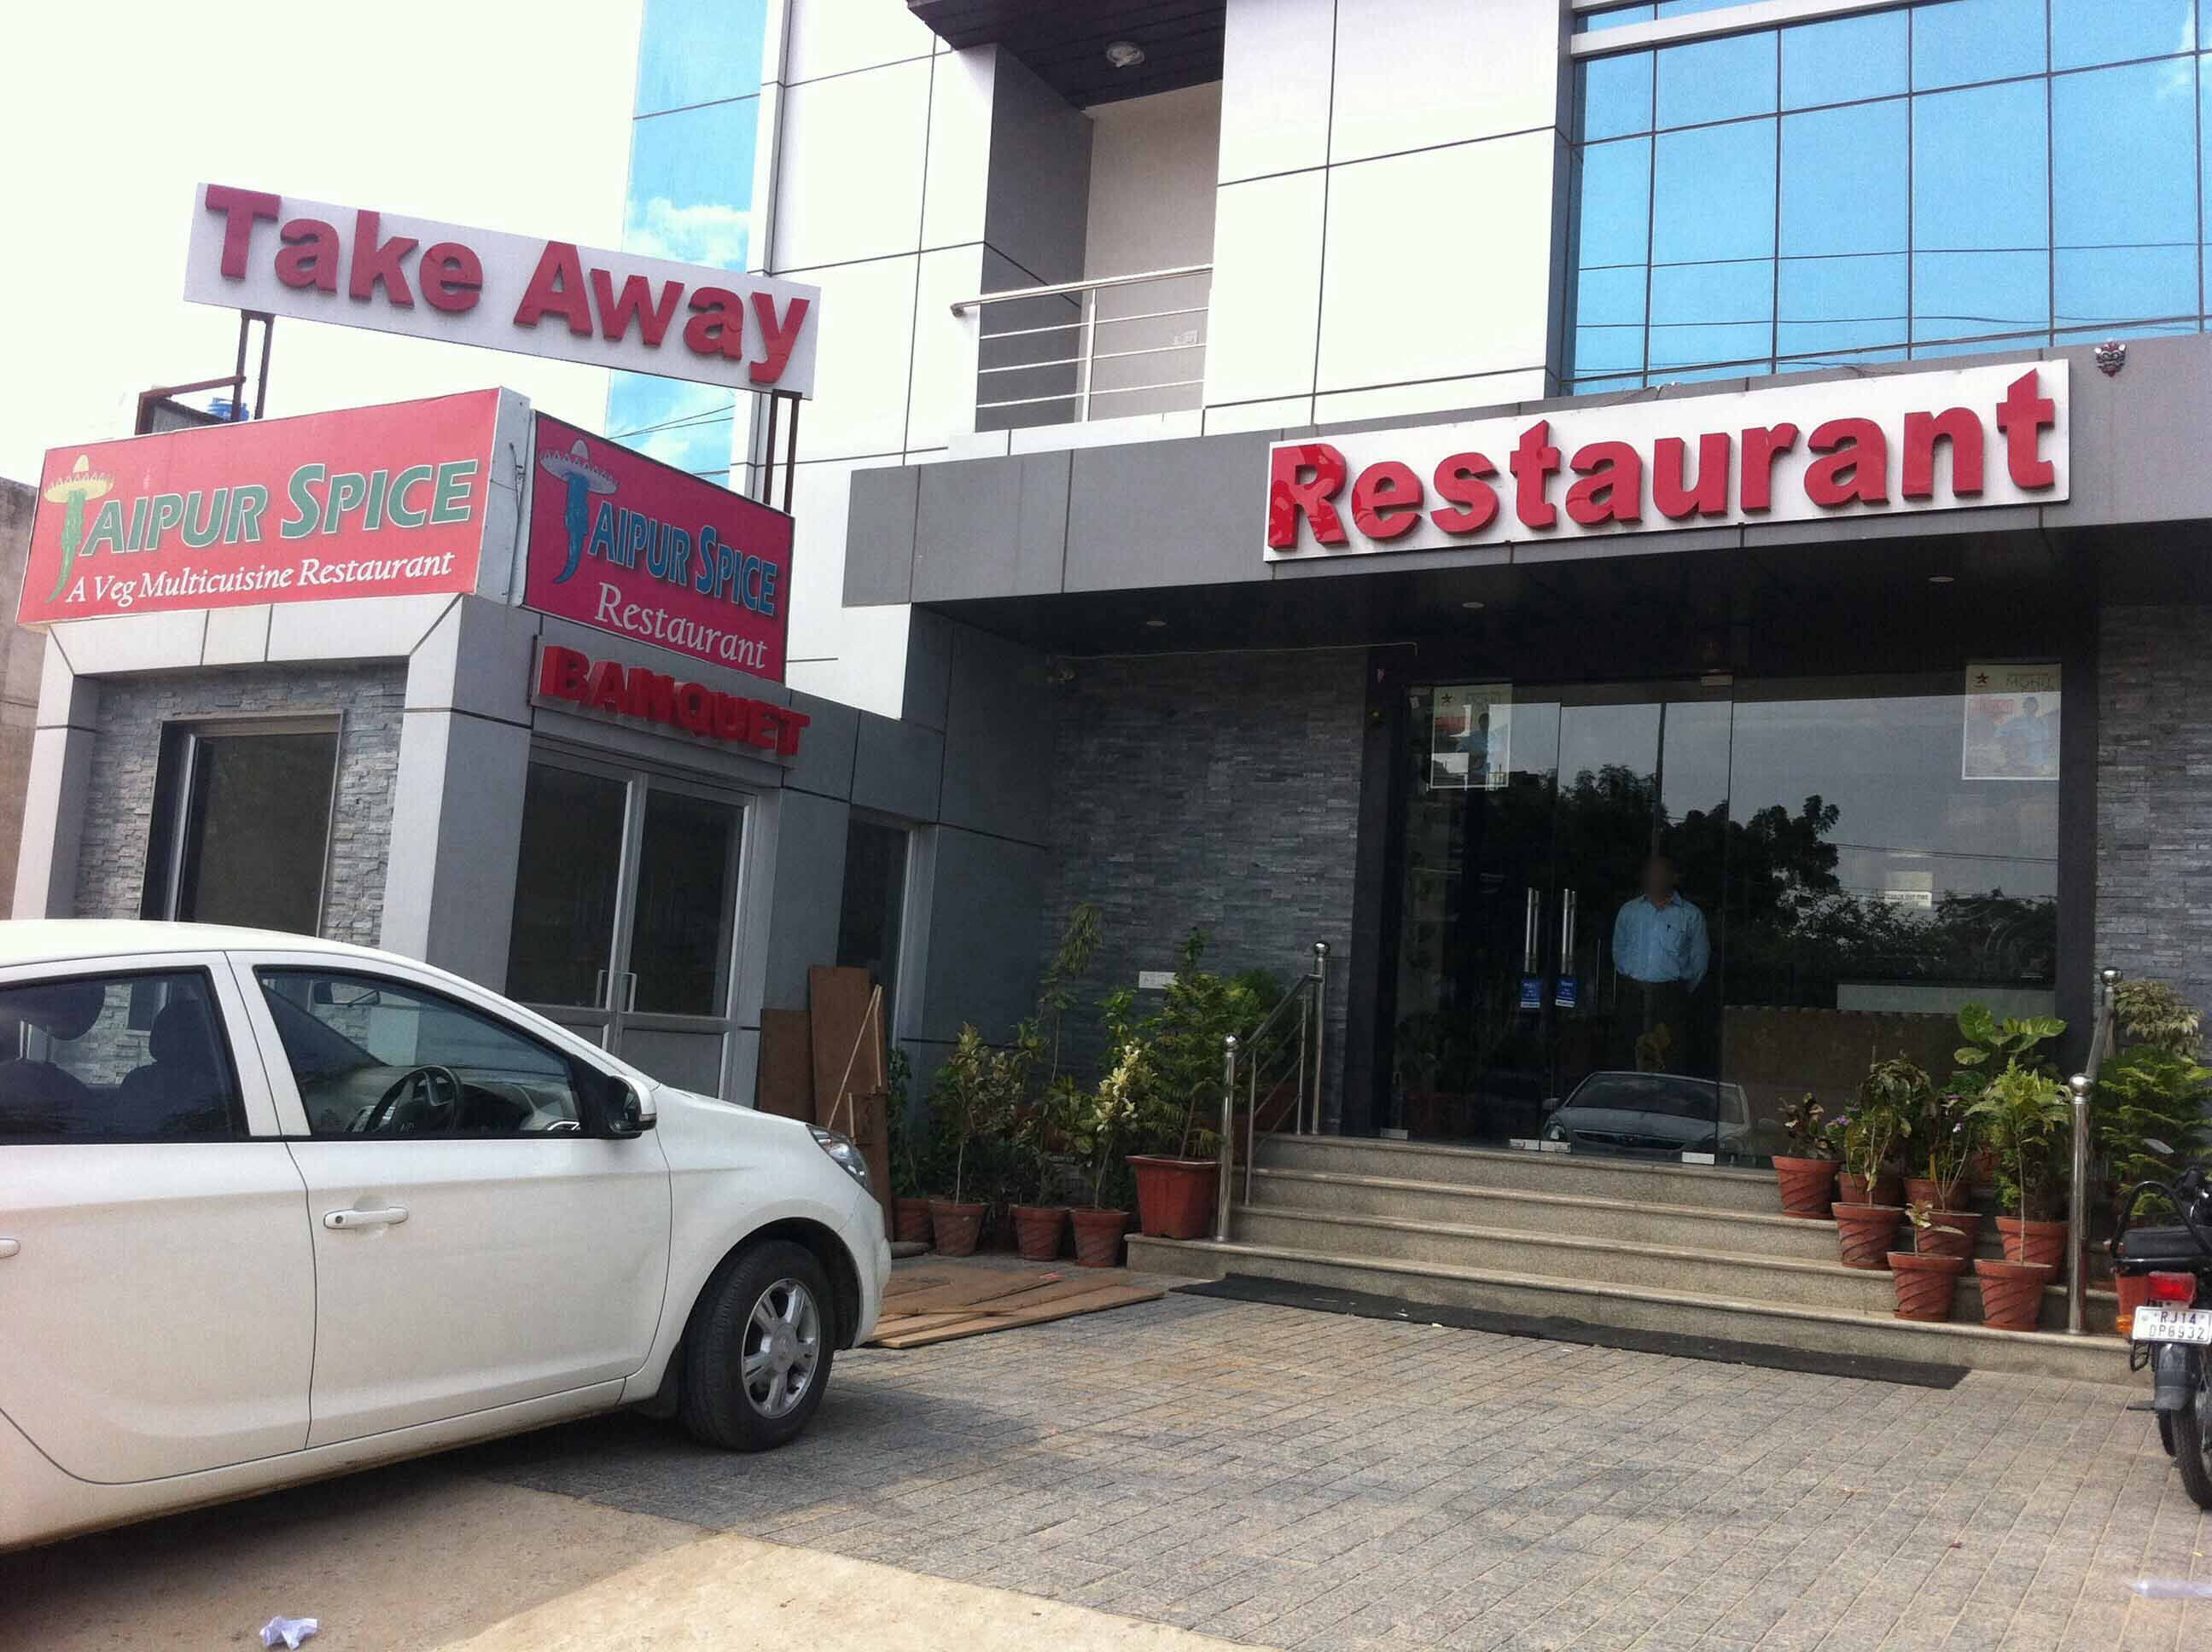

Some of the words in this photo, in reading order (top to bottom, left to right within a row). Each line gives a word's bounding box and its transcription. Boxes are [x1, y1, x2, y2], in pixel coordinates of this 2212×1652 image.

[205, 184, 483, 313] Take
[514, 241, 810, 384] Away
[280, 459, 478, 539] SPICE
[1268, 369, 2054, 550] Restaurant
[67, 582, 87, 602] A
[94, 577, 137, 607] Veg
[140, 563, 292, 600] Multicuisine
[299, 551, 455, 586] Restaurant
[696, 525, 777, 616] SPICE
[595, 582, 767, 669] Restaurant
[539, 645, 811, 756] BANQUET
